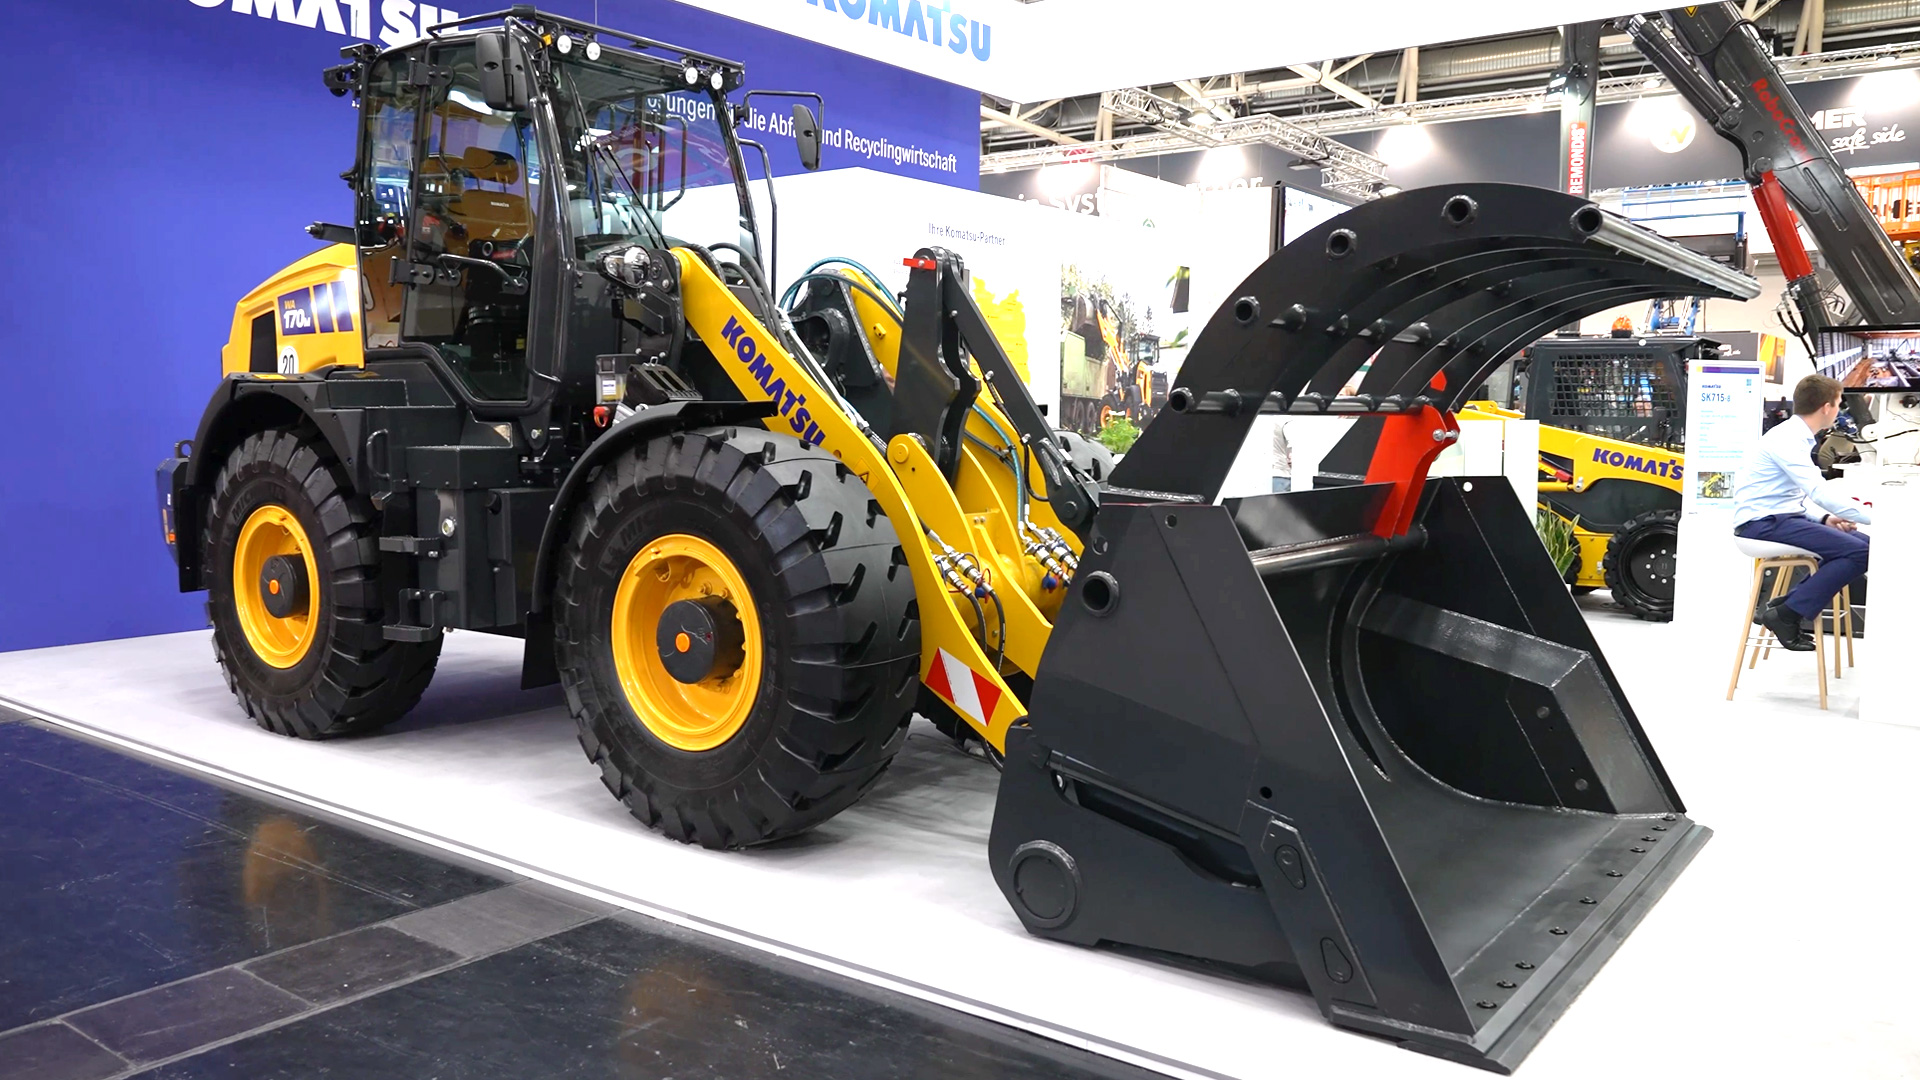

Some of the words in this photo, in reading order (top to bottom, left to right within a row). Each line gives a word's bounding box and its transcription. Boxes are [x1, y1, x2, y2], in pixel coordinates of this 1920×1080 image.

[806, 0, 991, 62] MATSU
[1807, 106, 1867, 131] MER
[1870, 123, 1906, 145] side
[845, 129, 957, 173] Recyclingwirtschaft
[928, 222, 944, 237] Ihre
[945, 225, 1006, 246] Komatsu-Partner
[282, 354, 295, 374] 20
[720, 314, 827, 447] KOMATSU
[1592, 447, 1685, 481] KOMATS
